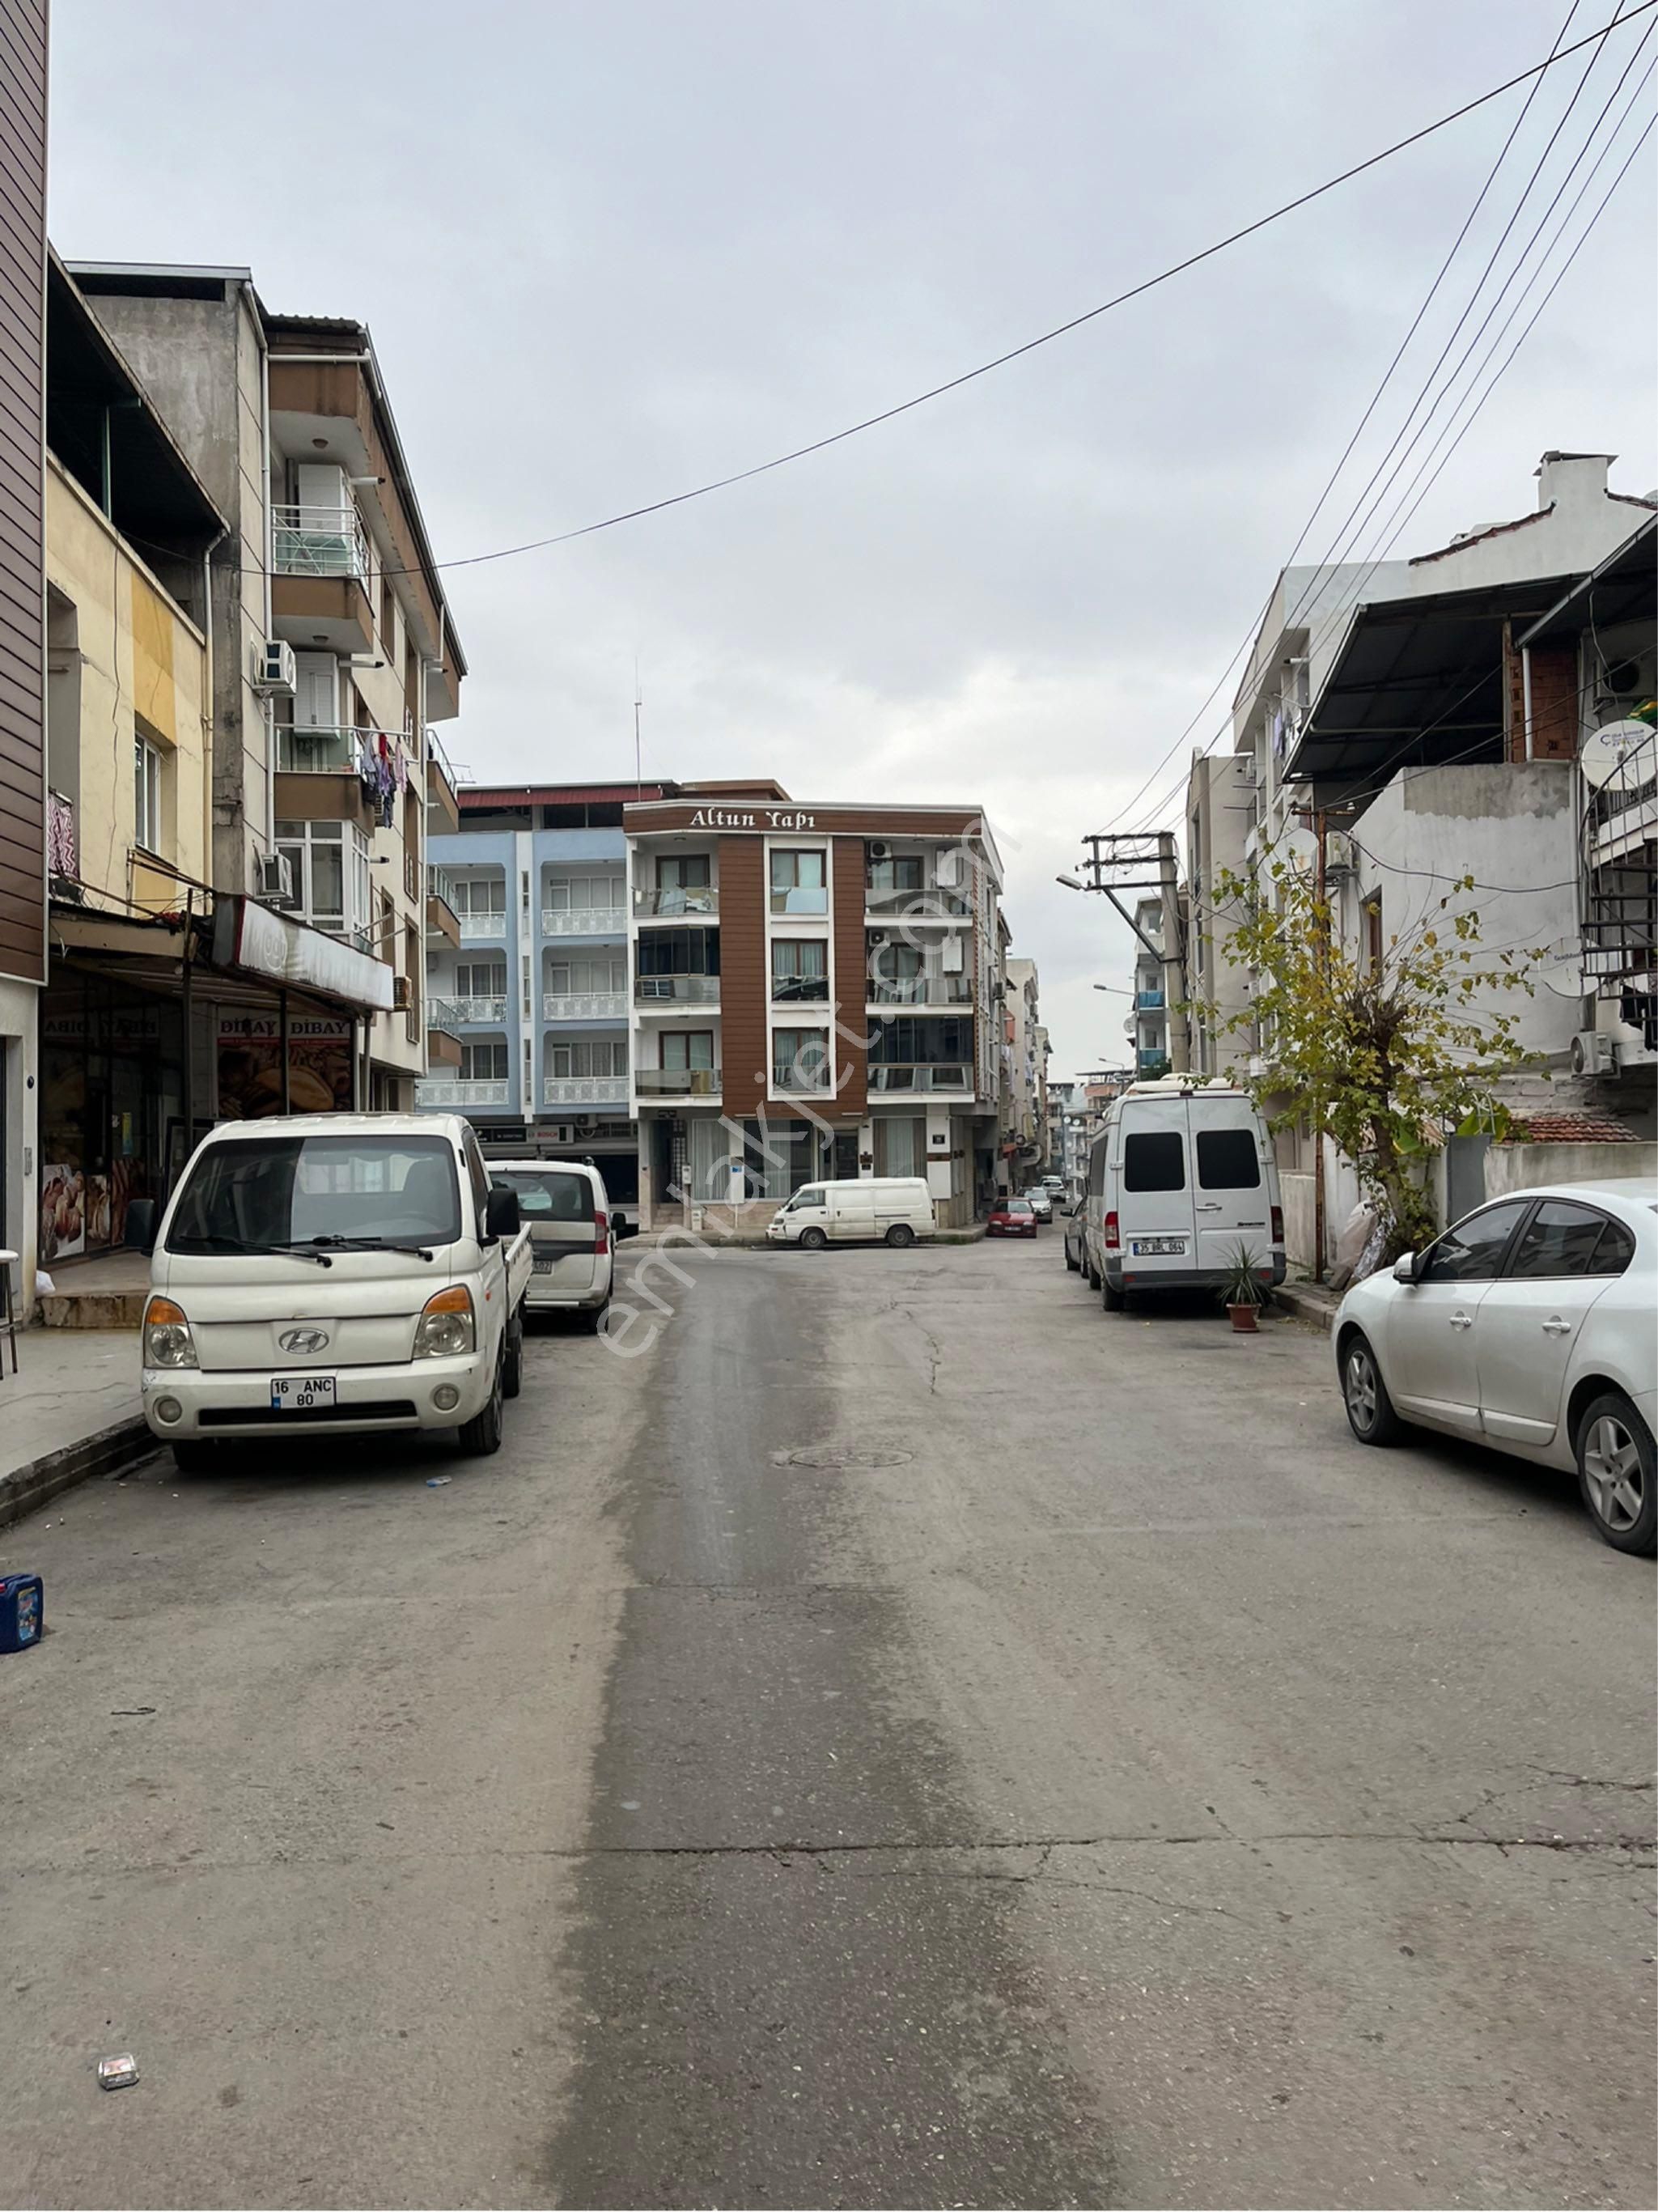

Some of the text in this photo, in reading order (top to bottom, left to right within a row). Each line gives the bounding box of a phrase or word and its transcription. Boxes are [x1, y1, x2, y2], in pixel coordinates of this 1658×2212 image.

[689, 807, 816, 830] Altun Yapı
[290, 1018, 346, 1034] DİBAY
[274, 1379, 332, 1394] 16 ANC
[296, 1393, 314, 1407] 80
